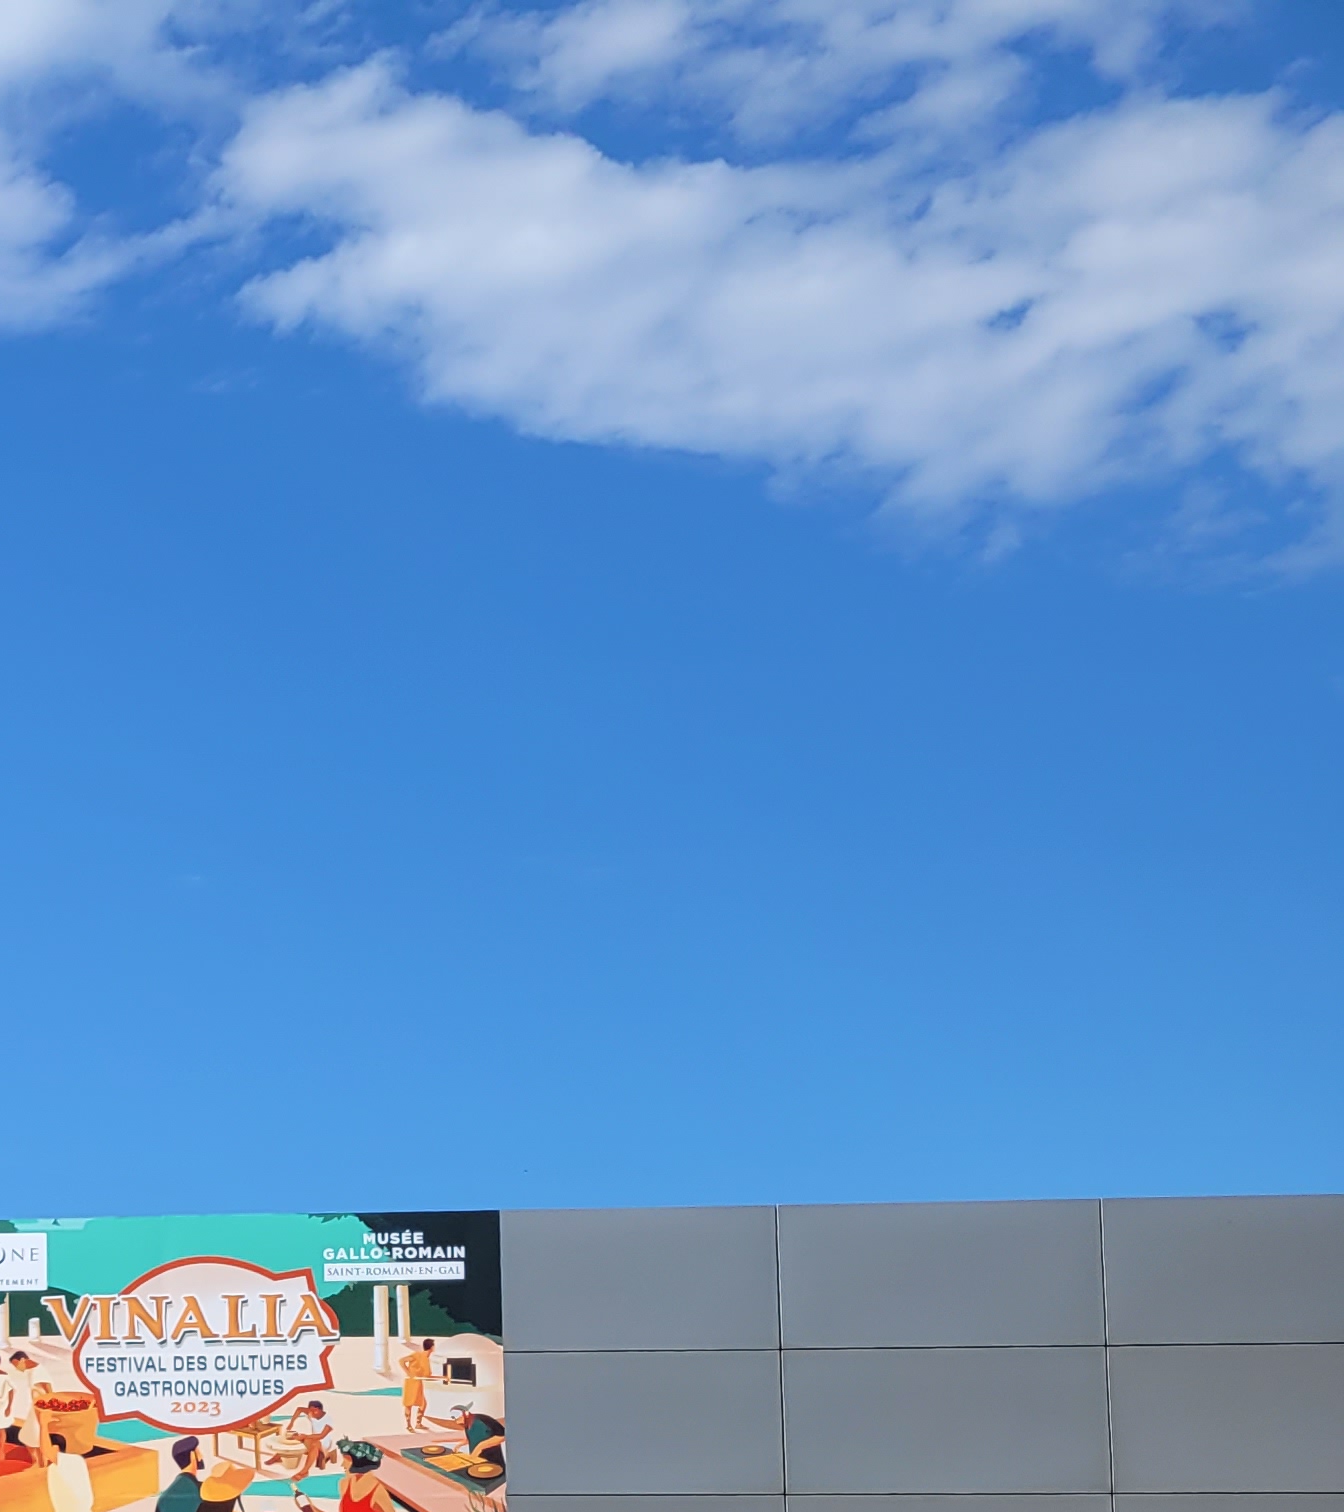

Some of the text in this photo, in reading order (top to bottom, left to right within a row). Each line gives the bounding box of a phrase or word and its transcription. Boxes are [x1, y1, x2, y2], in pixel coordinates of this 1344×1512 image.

[363, 1229, 424, 1245] MUSÉE
[322, 1246, 466, 1261] GALLO-ROMAIN
[326, 1265, 461, 1277] SAINT-ROMAIN-EN-GAL
[41, 1291, 339, 1345] VINALIA
[85, 1353, 308, 1373] FESTIVAL DES CULTURES
[114, 1379, 285, 1398] GASTRONOMIQUES
[170, 1400, 222, 1417] 2023
